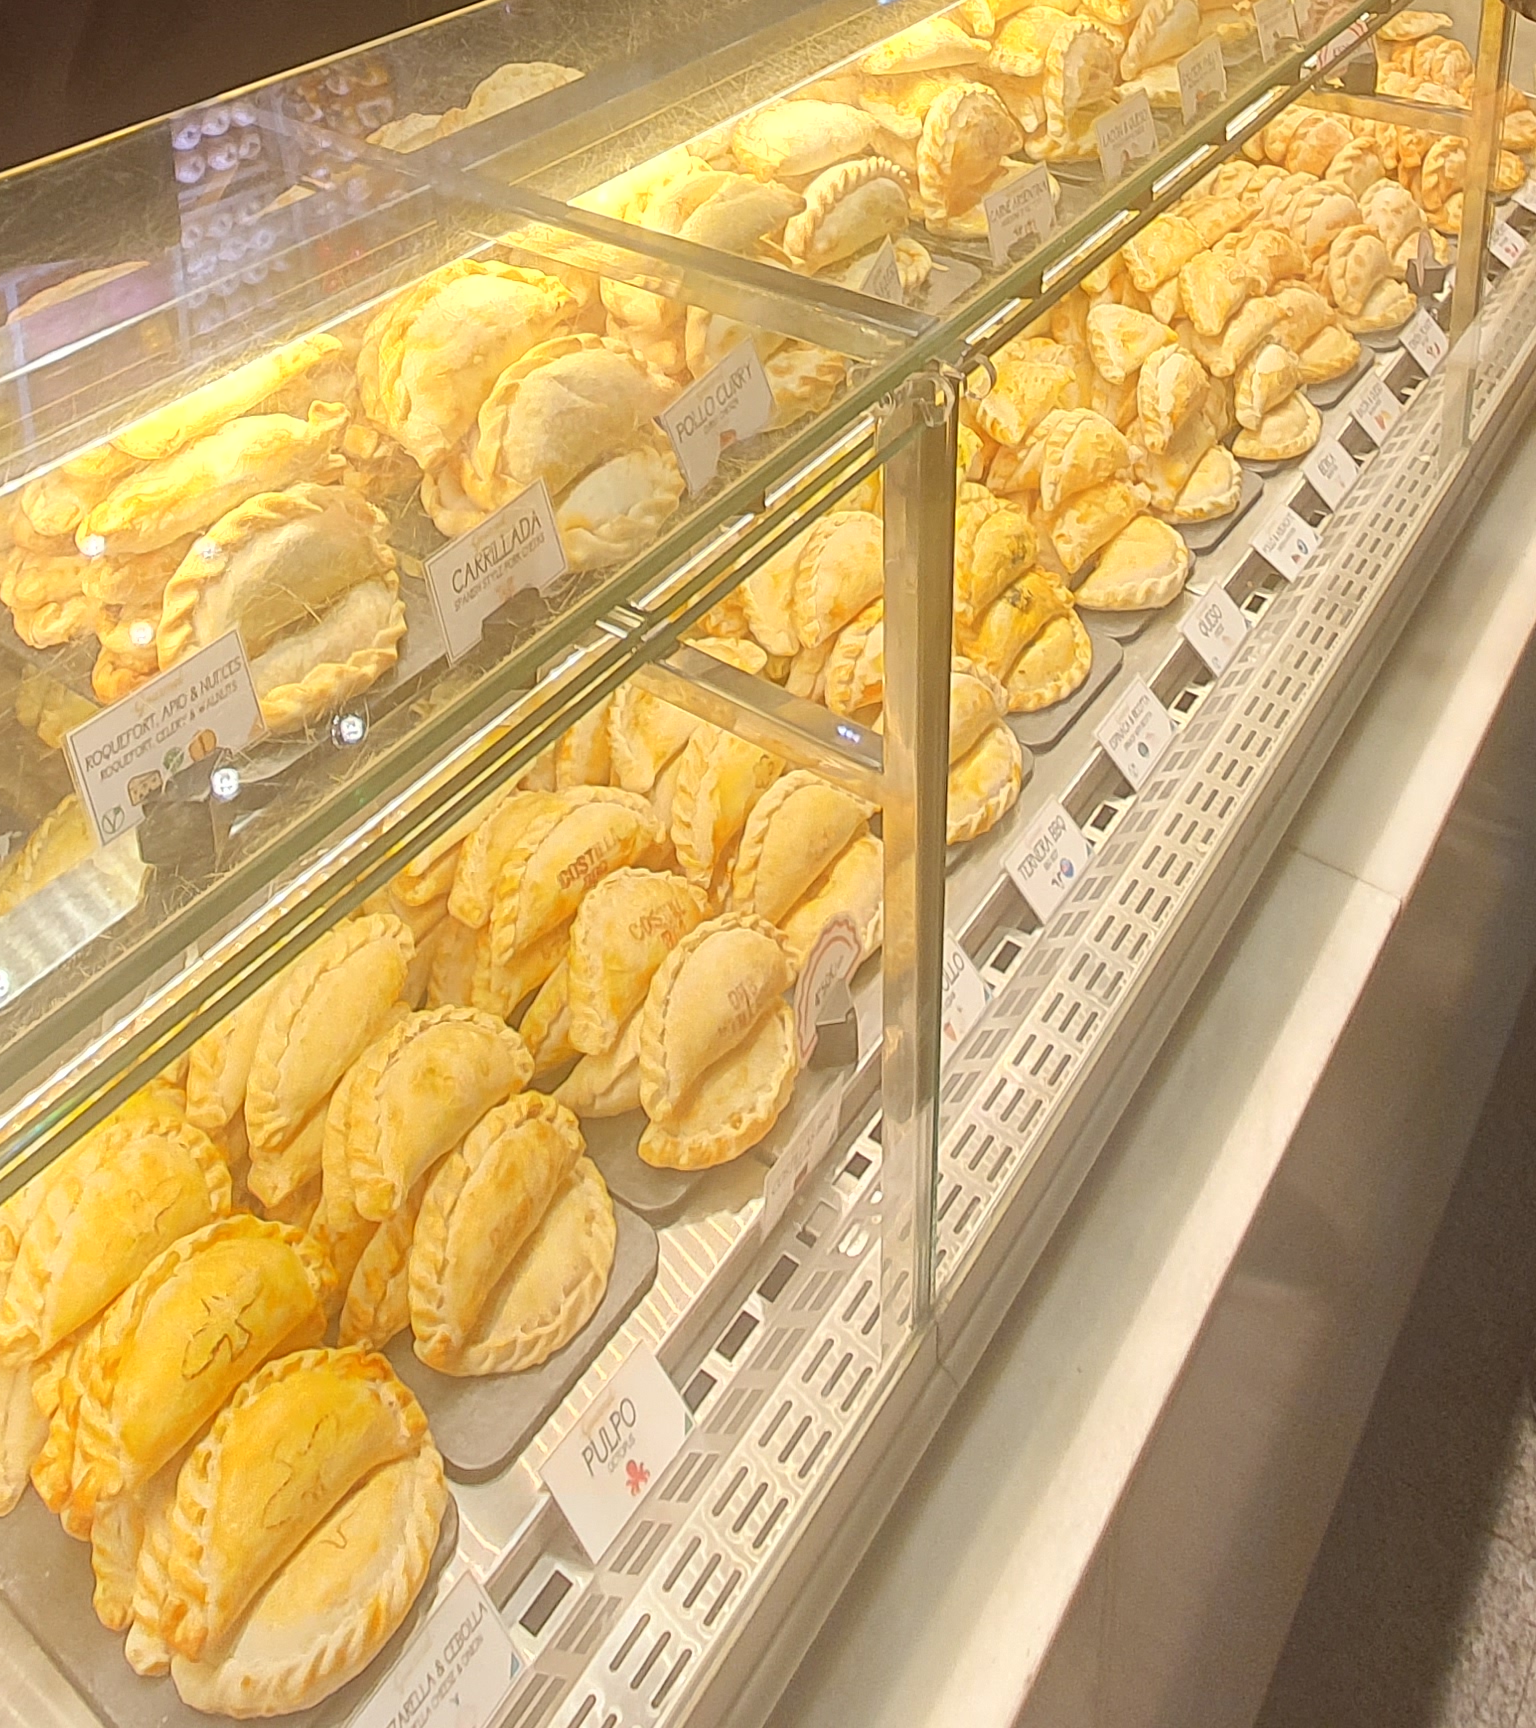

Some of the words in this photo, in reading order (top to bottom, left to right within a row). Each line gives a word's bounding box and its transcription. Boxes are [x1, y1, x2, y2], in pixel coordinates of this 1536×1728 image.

[675, 395, 715, 444] POLLO
[715, 361, 754, 406] CURRY
[451, 510, 542, 594] CARRILLADA
[189, 686, 200, 701] &
[581, 1397, 637, 1478] PULPO
[434, 1658, 446, 1677] &
[442, 1601, 489, 1664] CEBOLLA
